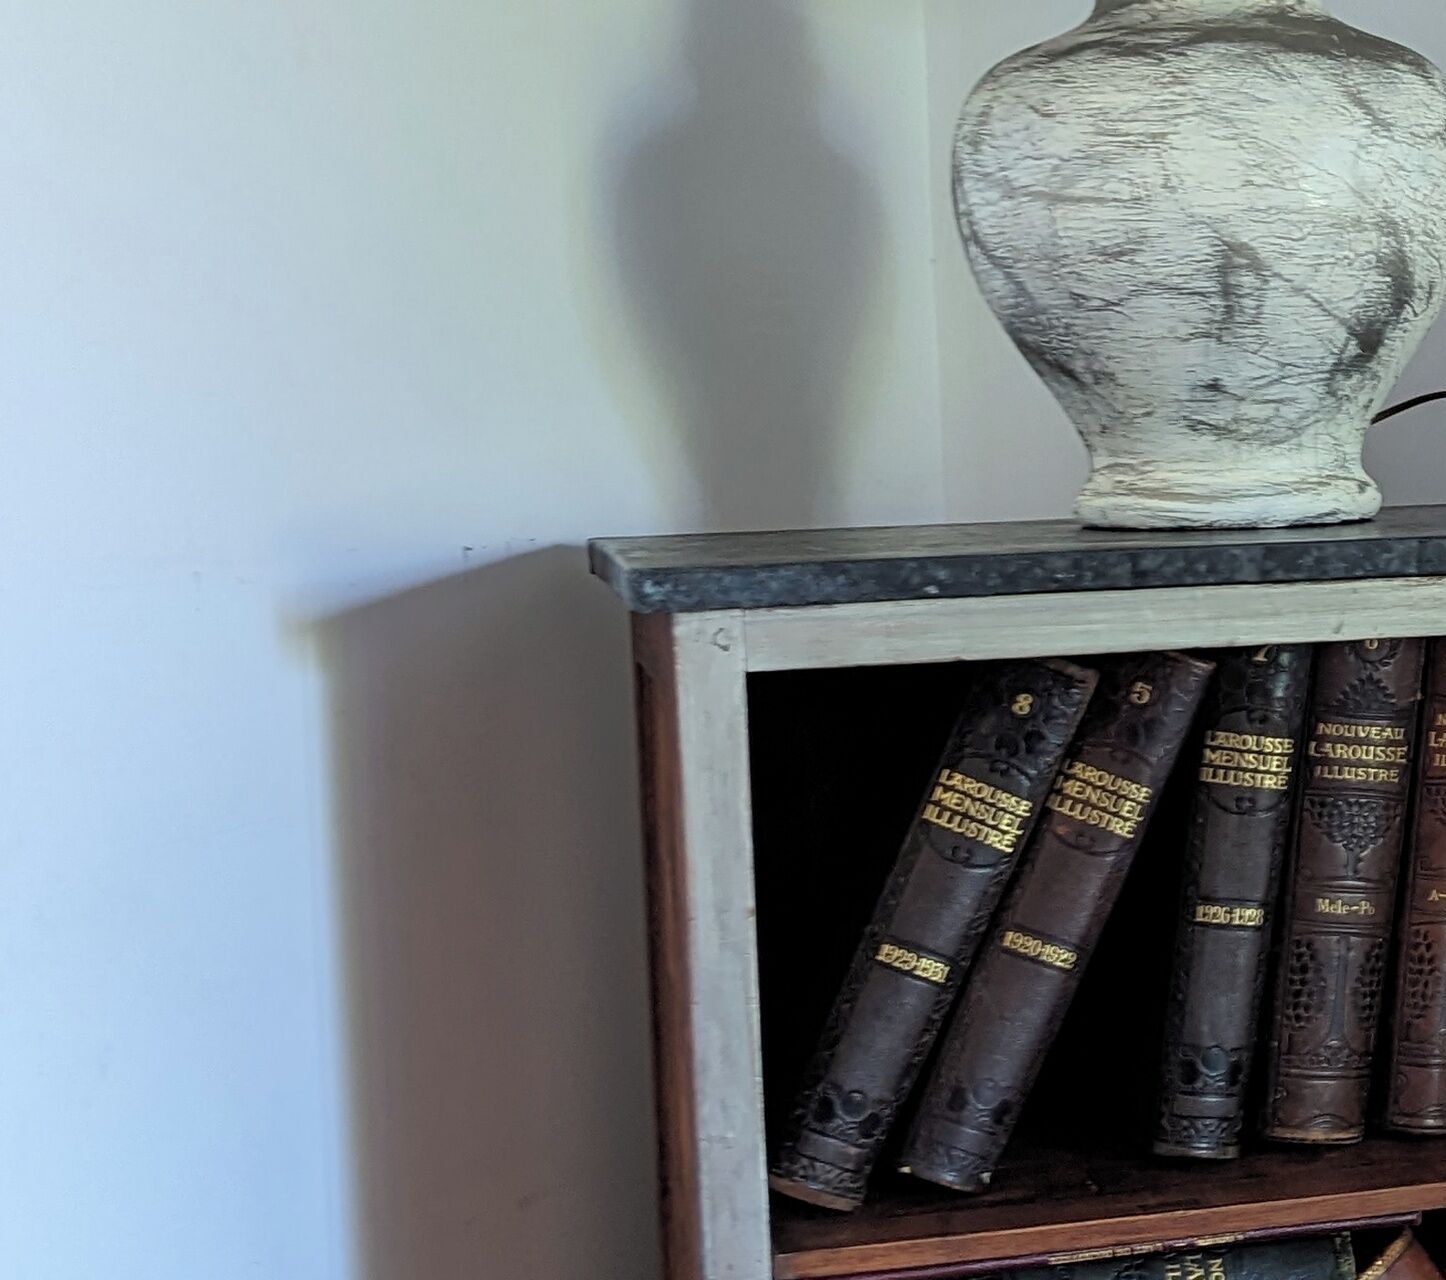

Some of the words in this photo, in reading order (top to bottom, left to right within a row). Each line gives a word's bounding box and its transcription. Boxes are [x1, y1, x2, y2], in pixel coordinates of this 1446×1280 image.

[1011, 693, 1034, 715] 8
[1129, 682, 1153, 704] 5
[1205, 730, 1295, 754] LAROUSSE
[1317, 723, 1406, 740] NOUVEAU
[1202, 748, 1292, 773] MENSUEL
[1308, 741, 1408, 764] LAROUSSE
[1064, 759, 1153, 803] LAROUSSE
[1200, 767, 1288, 790] ILLUSTRÉ
[939, 769, 1033, 817] LAROUSSE
[1054, 776, 1145, 821] MENSUEL
[931, 786, 1025, 835] MENSUEL
[922, 803, 1017, 853] ILLUSTRÉ
